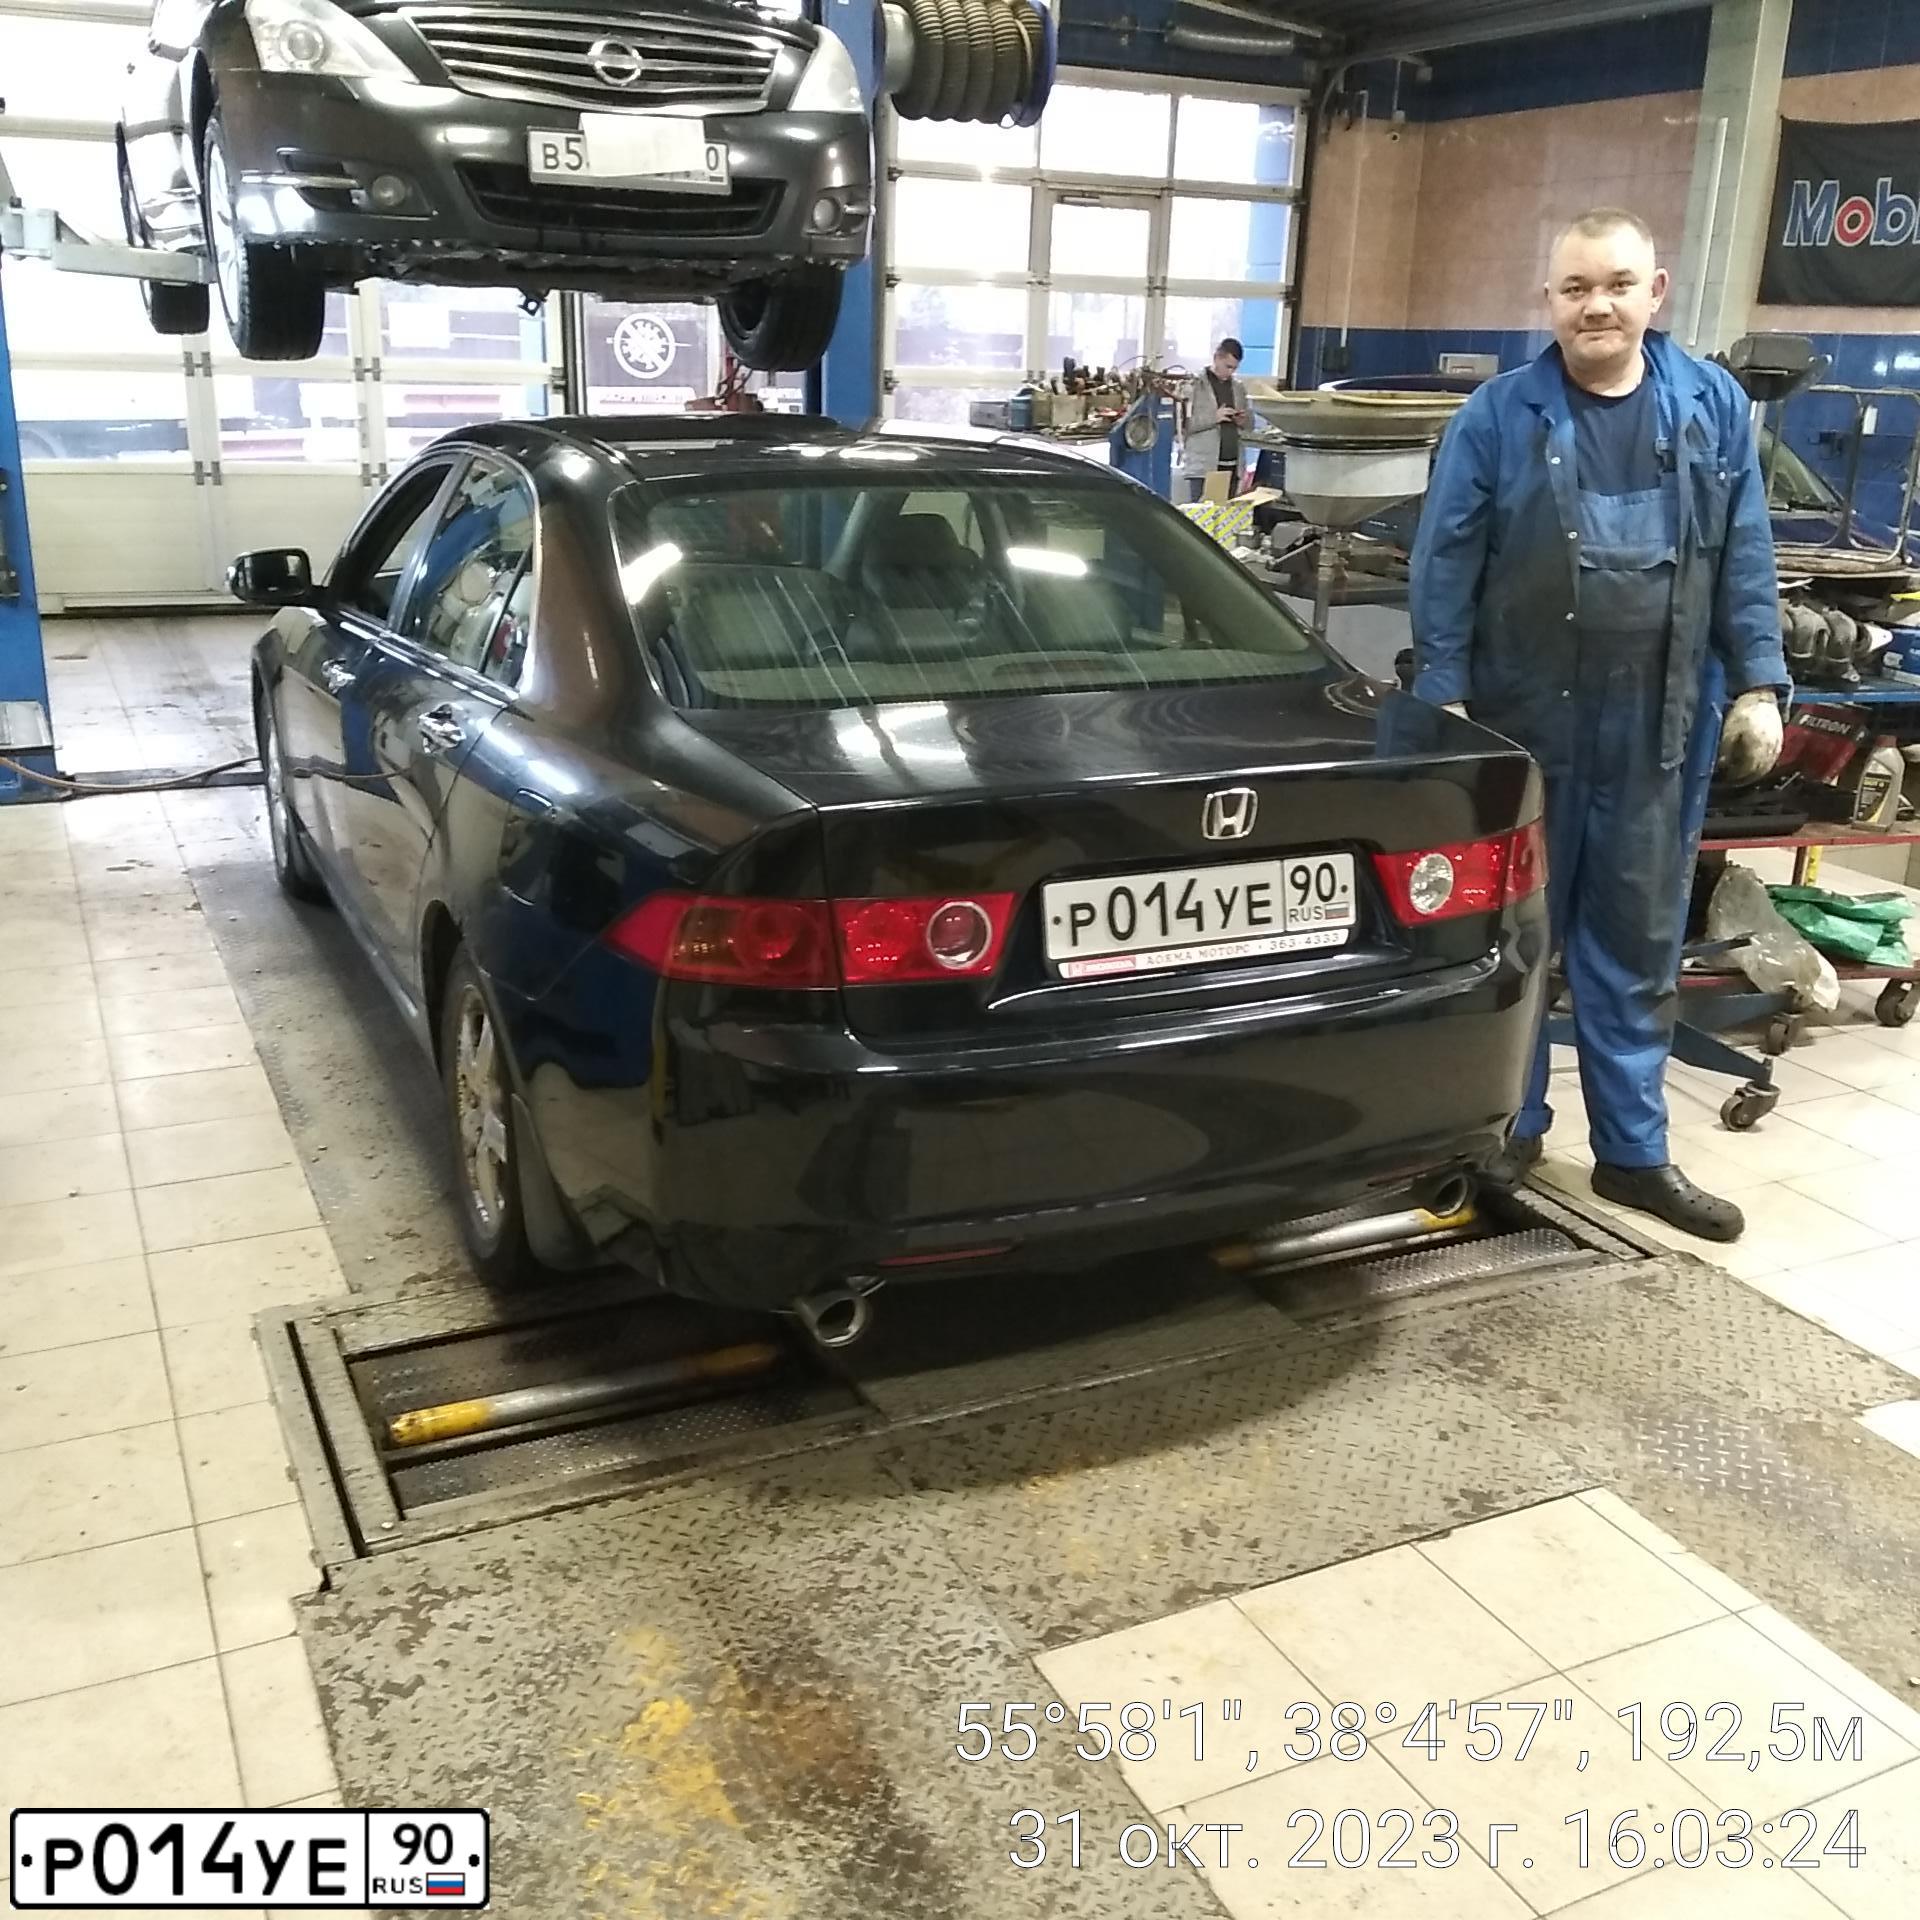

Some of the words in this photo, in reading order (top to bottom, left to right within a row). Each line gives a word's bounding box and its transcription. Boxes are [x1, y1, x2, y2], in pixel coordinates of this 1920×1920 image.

[1799, 714, 1851, 735] FILTRON
[1290, 862, 1337, 906] 90
[1288, 905, 1324, 923] RUS
